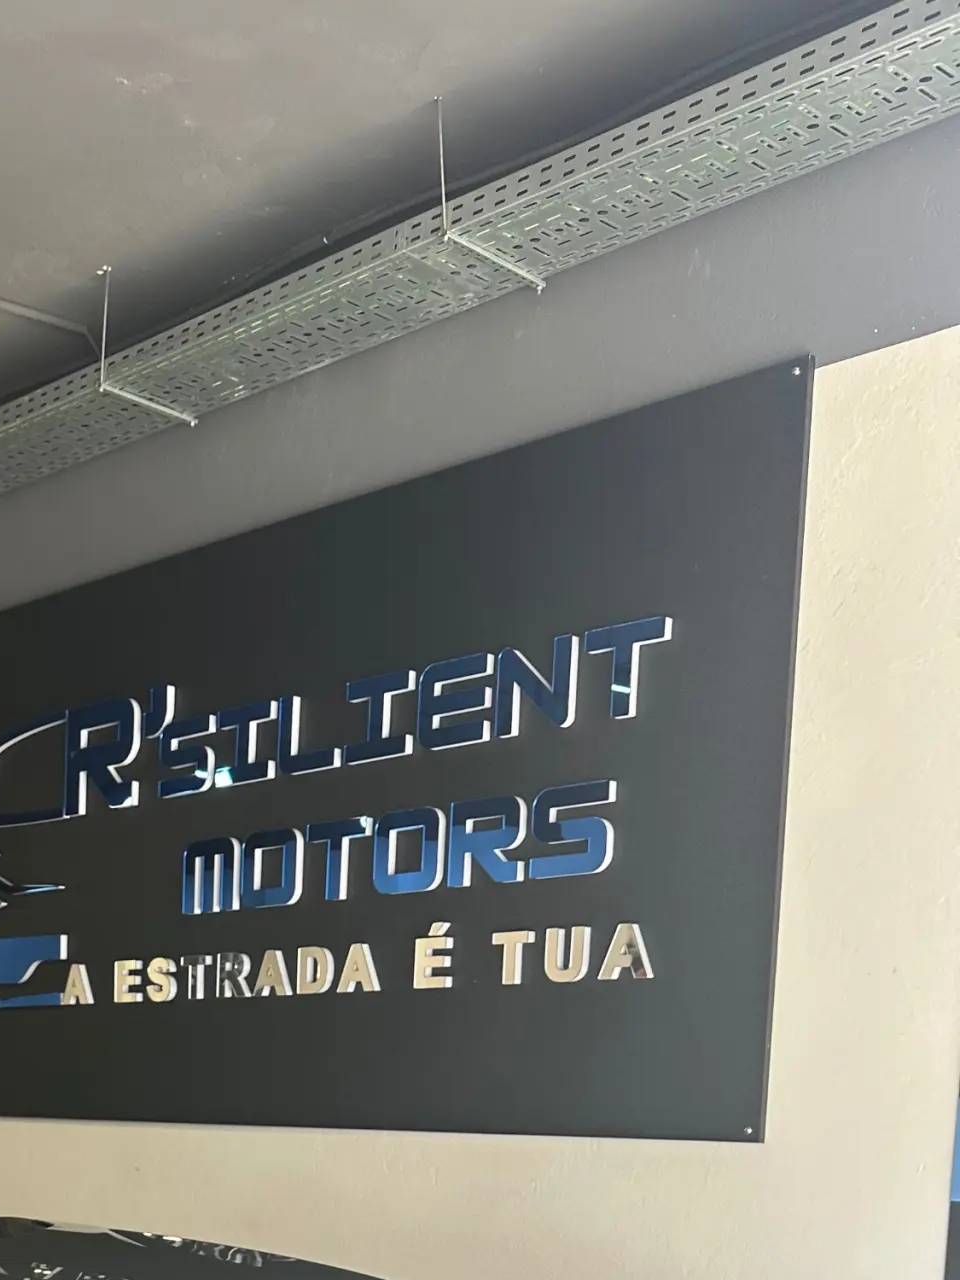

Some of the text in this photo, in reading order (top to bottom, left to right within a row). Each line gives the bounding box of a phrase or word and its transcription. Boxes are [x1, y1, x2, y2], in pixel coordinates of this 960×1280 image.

[182, 780, 617, 915] MOTORS
[60, 922, 655, 1005] A ESTRADA É TUA
